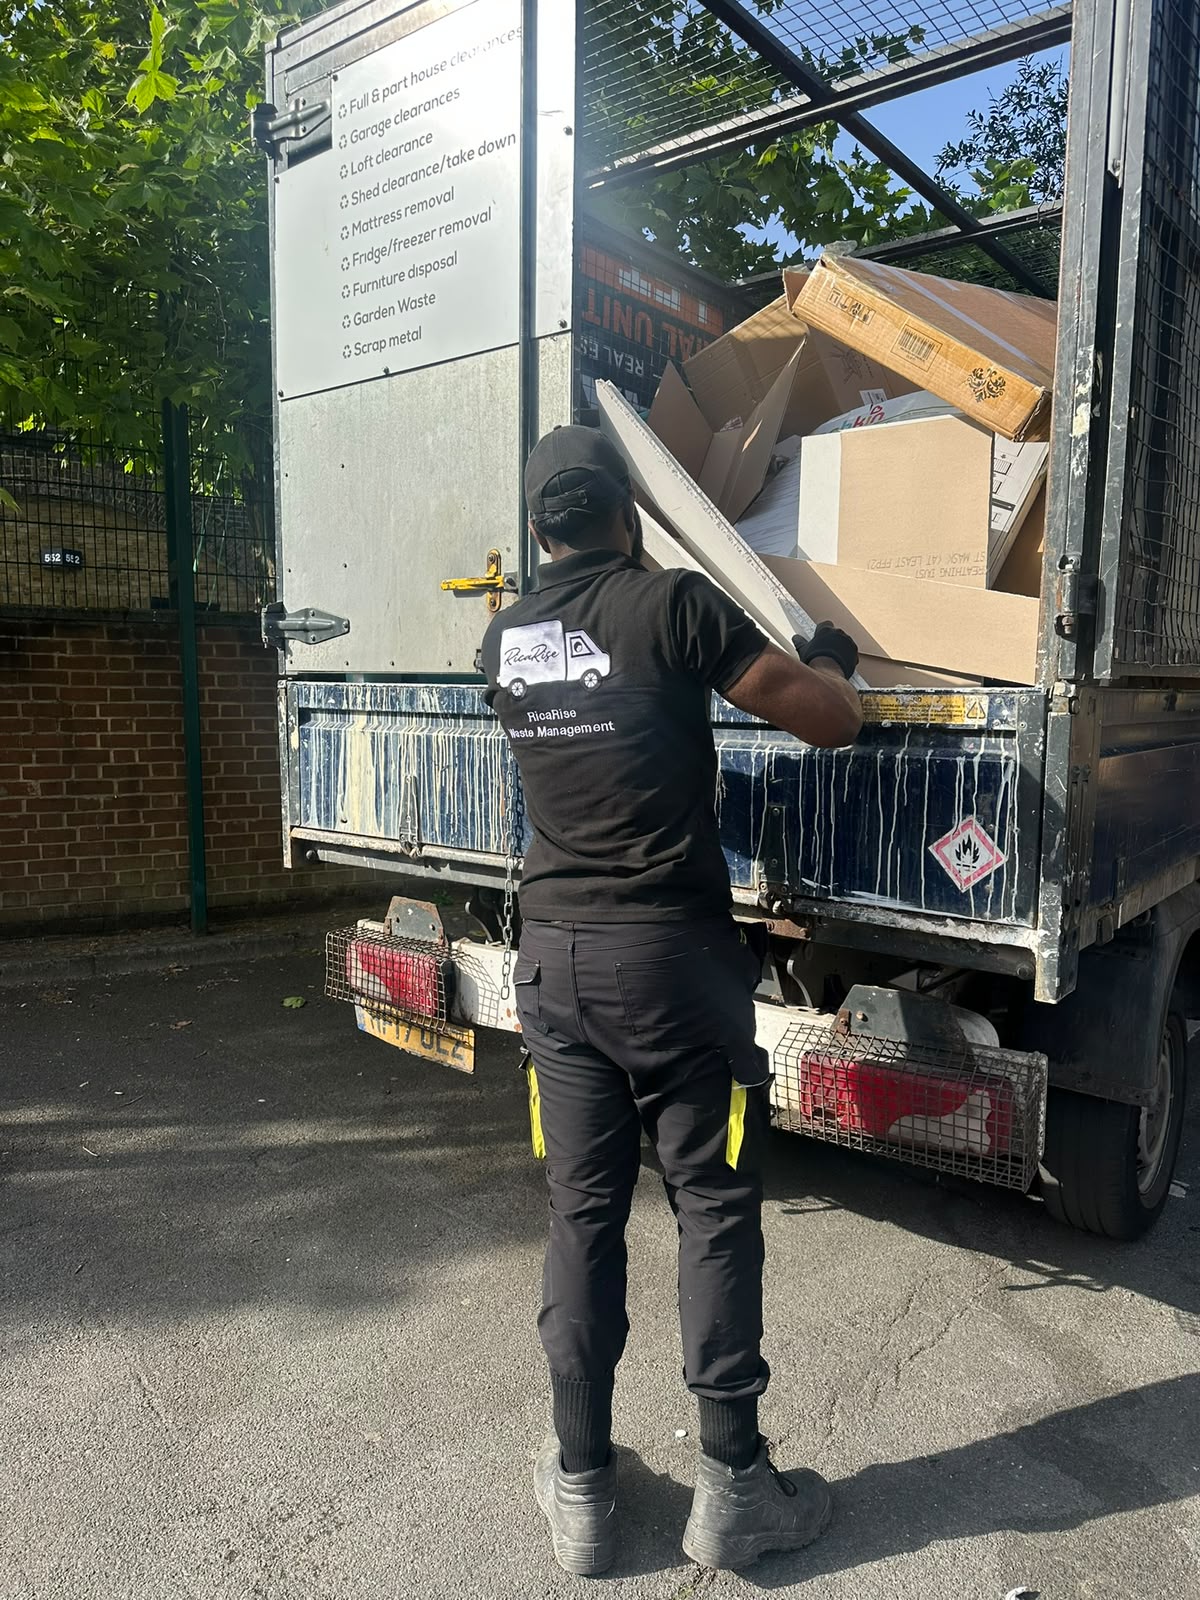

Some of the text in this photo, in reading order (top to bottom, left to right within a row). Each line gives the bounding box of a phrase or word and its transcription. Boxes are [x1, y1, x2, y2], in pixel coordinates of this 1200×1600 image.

[350, 92, 369, 114] Full
[371, 88, 380, 103] &
[382, 76, 408, 103] part
[410, 60, 448, 86] house
[350, 87, 460, 144] Garage clearances
[351, 132, 433, 175] Loft clearance
[351, 133, 516, 206] Shed clearance/take down
[352, 186, 455, 237] Mattress removal
[352, 206, 492, 267] Fridge/freezer removal
[353, 250, 458, 296] Furniture disposal
[353, 292, 436, 326] Garden Waste
[582, 287, 653, 348] UNIT
[354, 325, 422, 356] Scrap metal
[603, 345, 645, 376] REAL
[895, 555, 922, 568] LEAST
[915, 568, 936, 578] DUST
[947, 552, 970, 565] MASK
[504, 643, 560, 666] RicaRise
[508, 720, 615, 739] Waste Management
[527, 708, 577, 723] RicaRise
